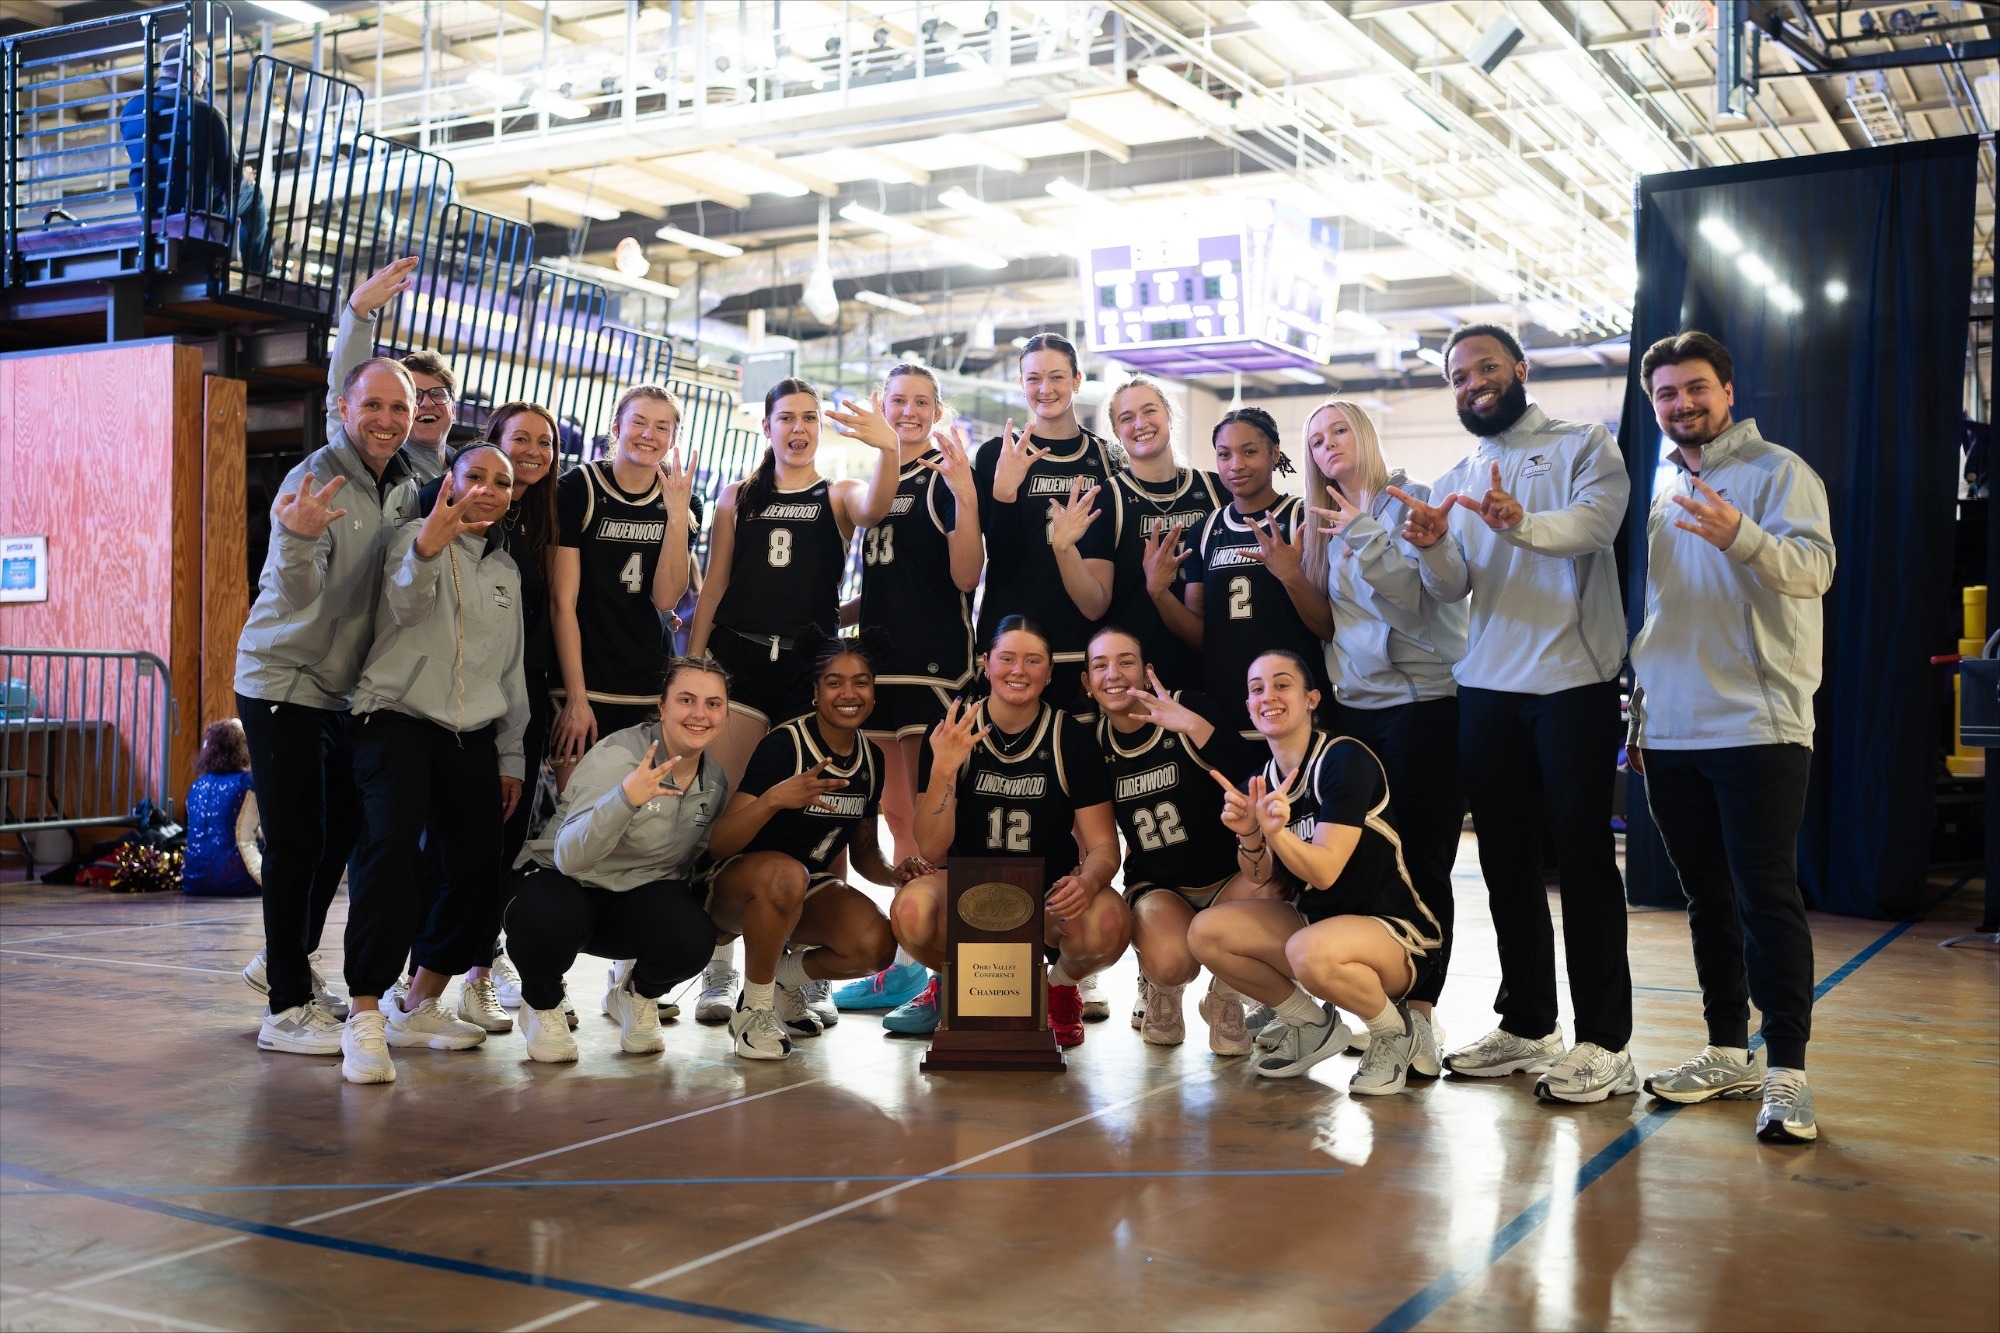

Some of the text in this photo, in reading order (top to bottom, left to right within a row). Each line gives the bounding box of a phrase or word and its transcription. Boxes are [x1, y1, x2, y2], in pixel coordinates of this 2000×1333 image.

[1031, 477, 1095, 493] LINDENWOD
[748, 505, 819, 518] DENWOOD
[600, 520, 664, 541] LINDENWOOD
[768, 528, 793, 567] 8
[865, 524, 895, 566] 33
[1212, 546, 1262, 567] LINDENW
[620, 552, 643, 593] 4
[1229, 576, 1252, 620] 2
[975, 773, 1045, 796] LINDENWOOD
[1118, 765, 1176, 799] LINDENWOOD
[987, 807, 1031, 852] 12
[1133, 801, 1188, 851] 22
[809, 827, 842, 862] 1
[974, 971, 1015, 979] CONFERENCE
[993, 963, 1017, 971] VALLEY
[969, 986, 1020, 996] CHAMPIONS
